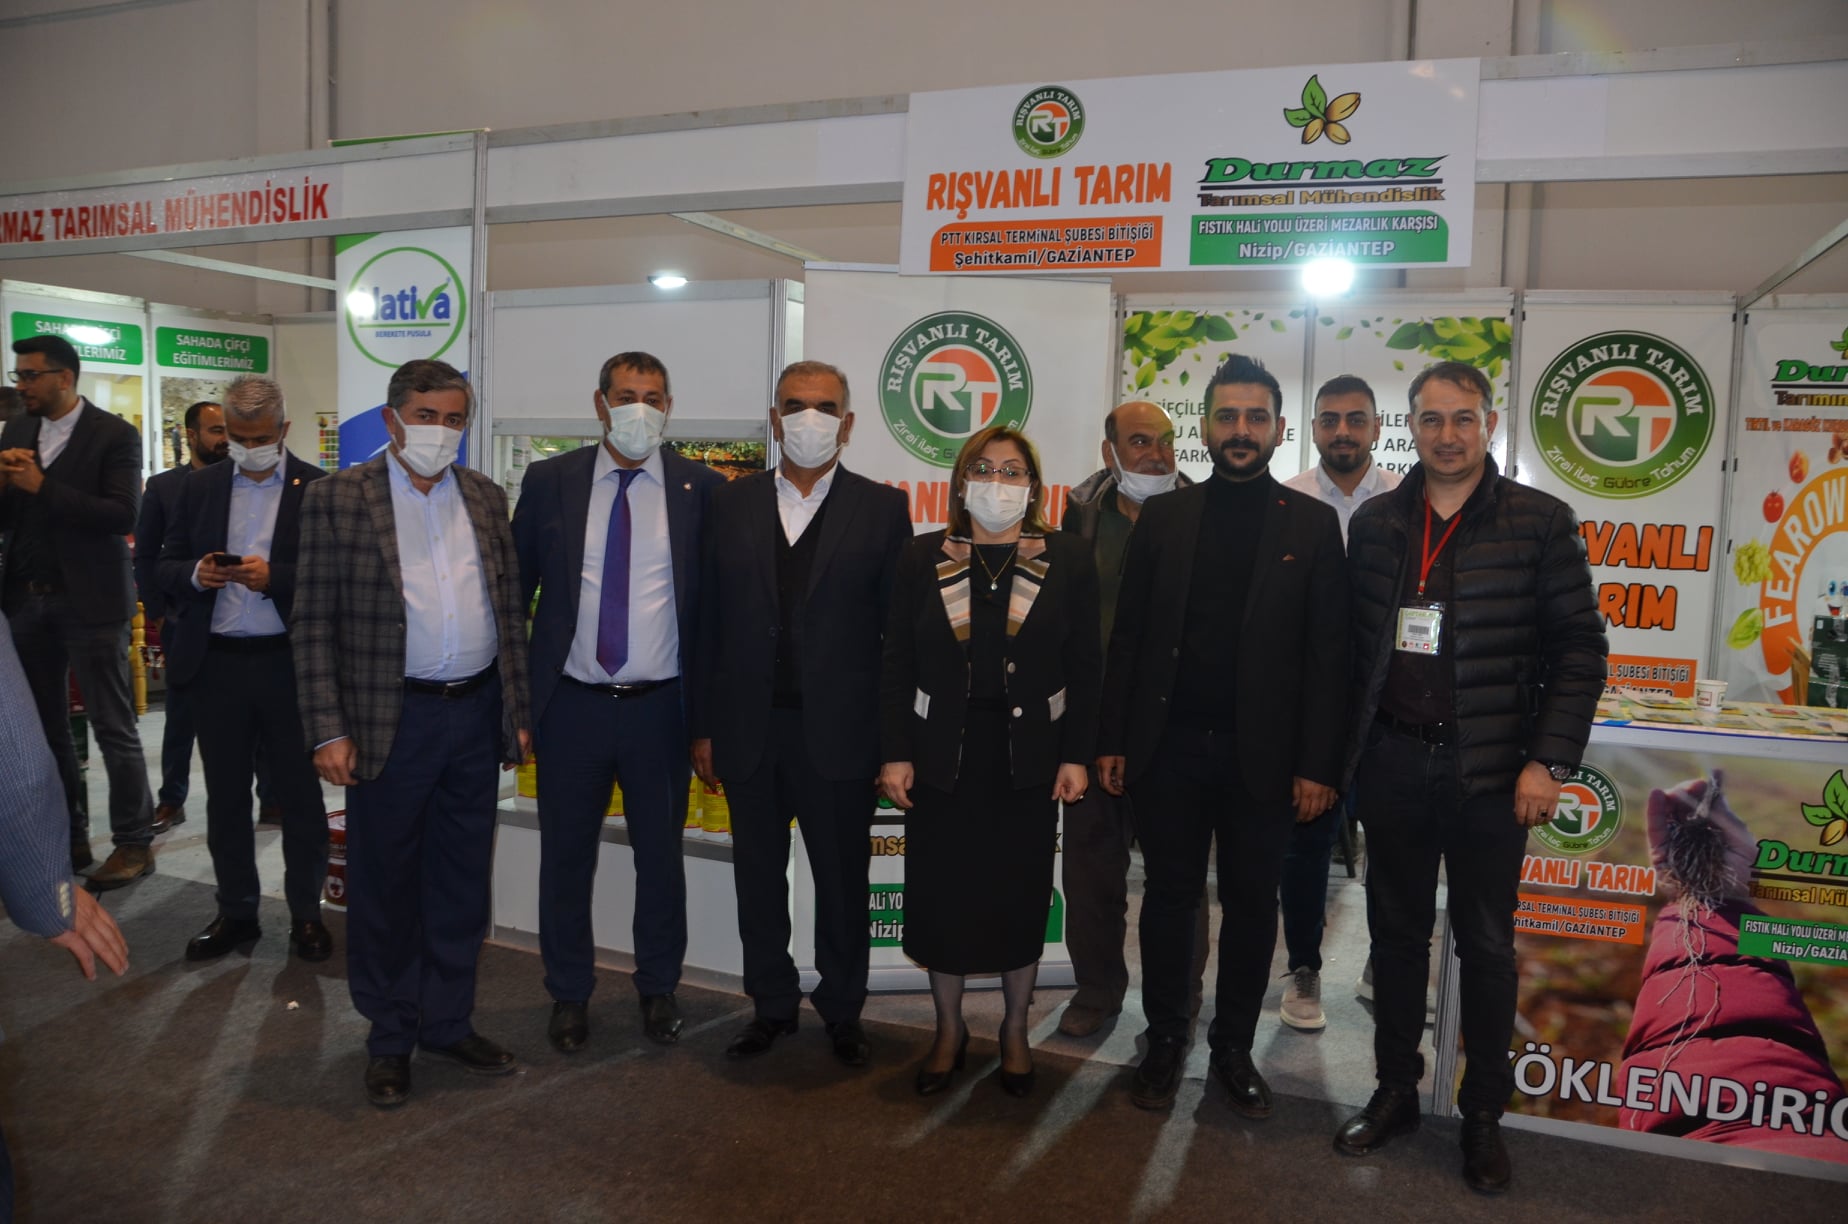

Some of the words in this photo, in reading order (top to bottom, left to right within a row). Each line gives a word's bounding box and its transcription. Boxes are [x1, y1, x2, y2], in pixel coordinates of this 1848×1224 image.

[1056, 91, 1081, 120] TARIM
[1197, 154, 1449, 184] Durmaz
[926, 166, 1062, 220] RIŞVANLI
[1074, 162, 1172, 206] TARIM
[1197, 190, 1295, 207] Tarımsal
[1299, 185, 1446, 205] Mühendislik
[0, 208, 44, 243] MAZ
[51, 200, 158, 241] TARIMSAL
[164, 176, 330, 233] MÜHENDİSLİK
[1198, 219, 1234, 234] FISTIK
[1264, 219, 1292, 233] YOLU
[1294, 215, 1328, 233] ÜZERİ
[1331, 216, 1389, 232] MEZARLIK
[1391, 215, 1439, 235] KARŞISI
[941, 231, 961, 245] PTT
[964, 229, 1003, 245] KIRSAL
[1239, 238, 1396, 260] Nizip/GAZİANTEP
[954, 247, 1136, 269] Şehitkamil/GAZİANTEP
[358, 281, 450, 320] ativa
[75, 344, 127, 361] LERİMİZ
[176, 334, 222, 350] SAHADA
[886, 322, 969, 394] RIŞVANLI
[975, 326, 1024, 392] TARIM
[172, 352, 254, 370] EĞİTİMLERİMİZ
[920, 361, 1001, 432] RT
[1540, 343, 1639, 418] RIŞVANLI
[1645, 348, 1704, 416] TARIM
[1573, 385, 1675, 461] RT
[1603, 476, 1652, 489] Gübre
[1649, 446, 1696, 481] Tohum
[1579, 520, 1714, 572] VANLI
[1598, 582, 1678, 631] RIM
[1586, 772, 1616, 812] TARIM
[1552, 792, 1602, 834] RT
[1520, 855, 1580, 888] ANLI
[1586, 861, 1657, 896] TARIM
[1749, 881, 1817, 904] Tarımsal
[1516, 900, 1535, 912] RSAL
[1513, 915, 1627, 938] hitkamil/GAZİANTEP
[1745, 920, 1770, 934] FISTIK
[1791, 925, 1812, 939] YOLU
[1508, 1041, 1848, 1141] ÖKLENDiRi
